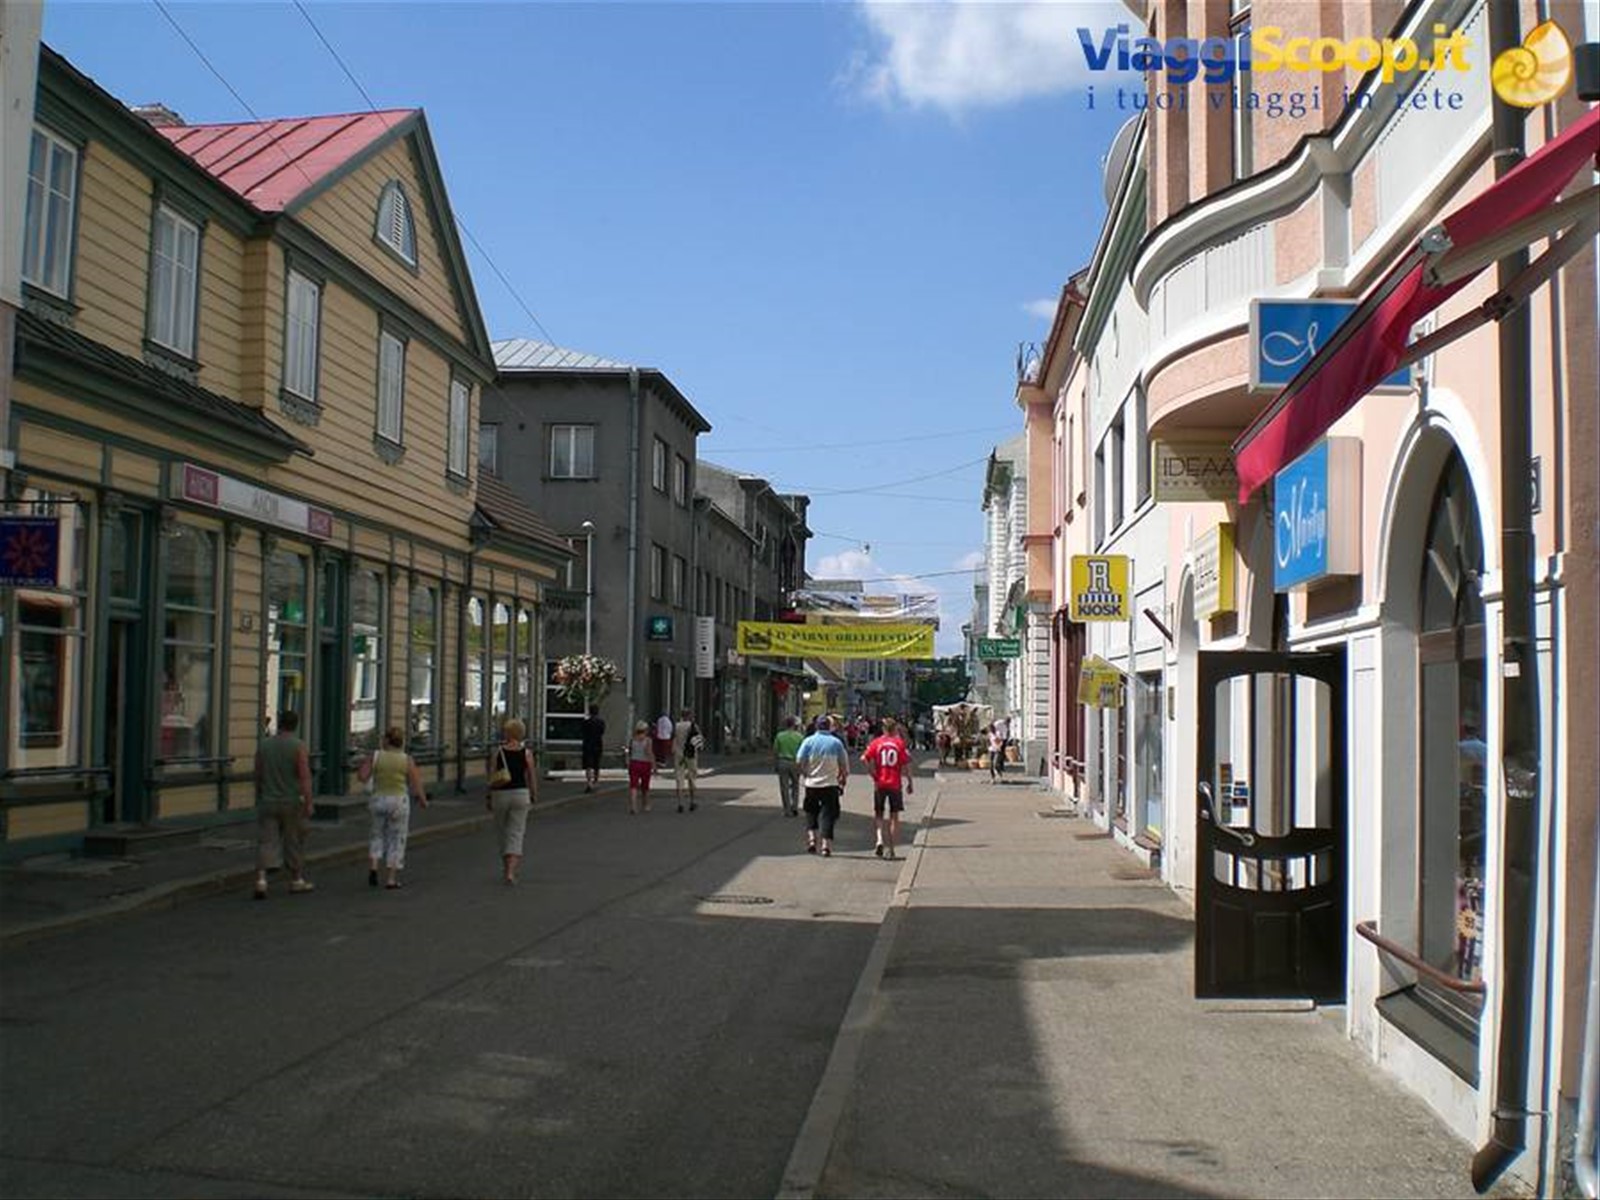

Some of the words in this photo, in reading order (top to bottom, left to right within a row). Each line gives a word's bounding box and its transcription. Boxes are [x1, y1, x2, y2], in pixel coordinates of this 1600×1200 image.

[1164, 457, 1238, 477] IDEAA
[1087, 560, 1112, 594] R
[1078, 604, 1122, 616] KIOSK
[881, 748, 898, 767] 10
